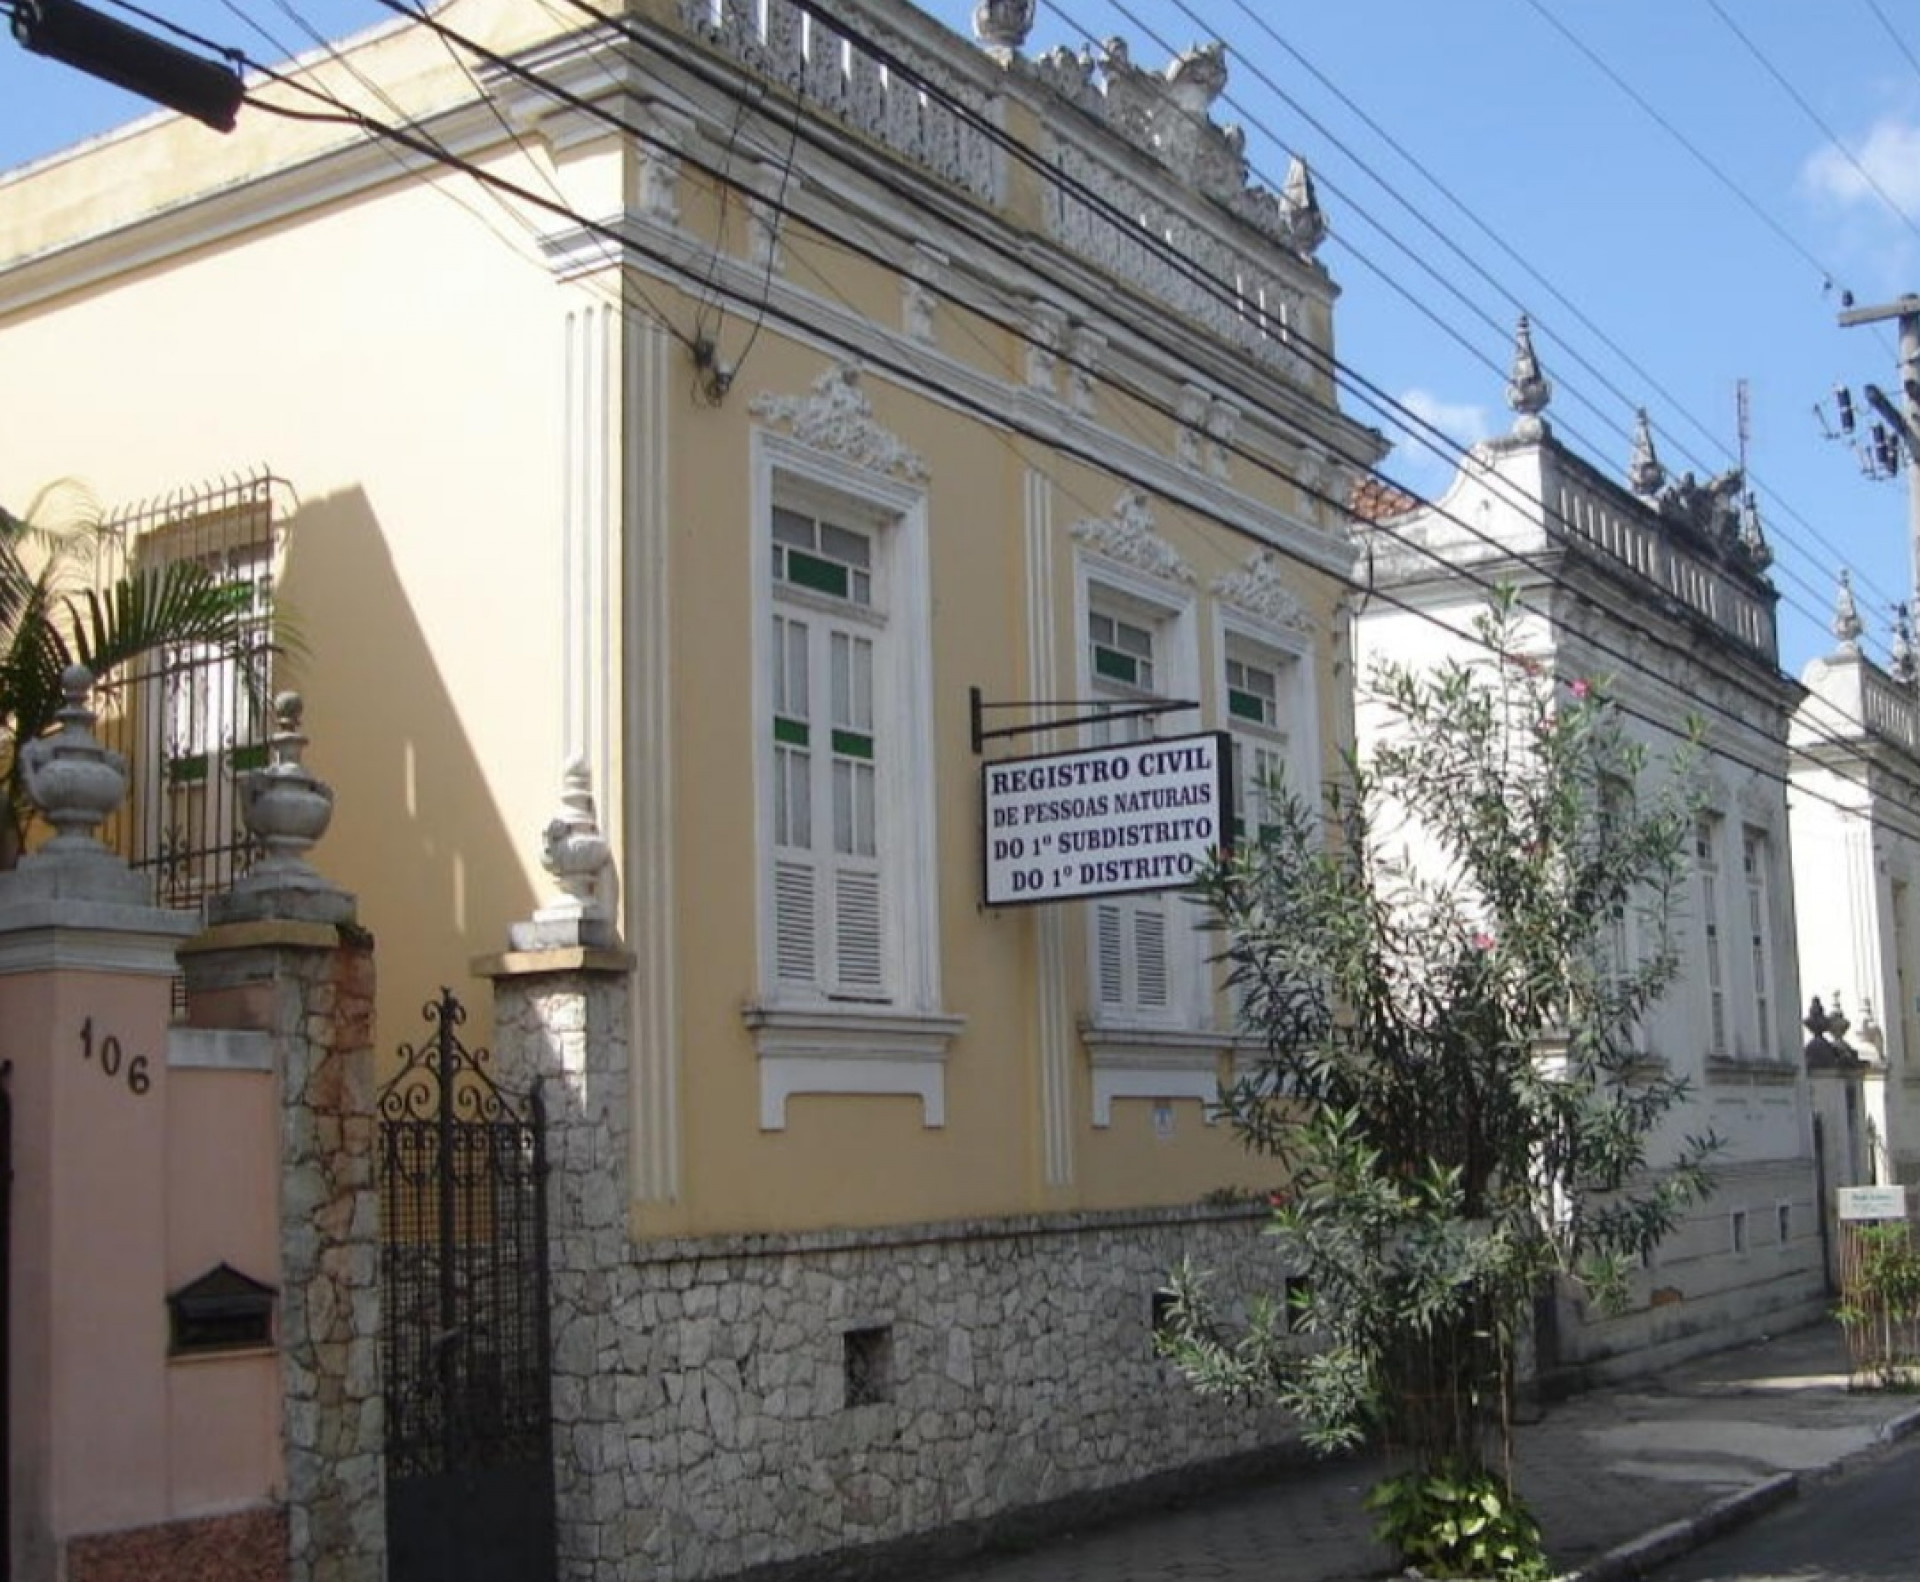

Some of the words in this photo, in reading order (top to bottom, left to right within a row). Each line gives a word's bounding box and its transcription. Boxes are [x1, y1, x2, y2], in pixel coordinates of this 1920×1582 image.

[992, 757, 1129, 795] REGISTRO
[1138, 747, 1211, 777] CIVIL
[994, 806, 1018, 828] DE
[1024, 796, 1108, 824] PESSOAS
[1114, 783, 1211, 813] NATURAIS
[994, 838, 1024, 861] DO
[1058, 817, 1212, 854] SUBDISTRITO
[1012, 869, 1044, 892] DO
[1080, 853, 1194, 885] DISTRITO
[80, 1016, 150, 1095] 106
